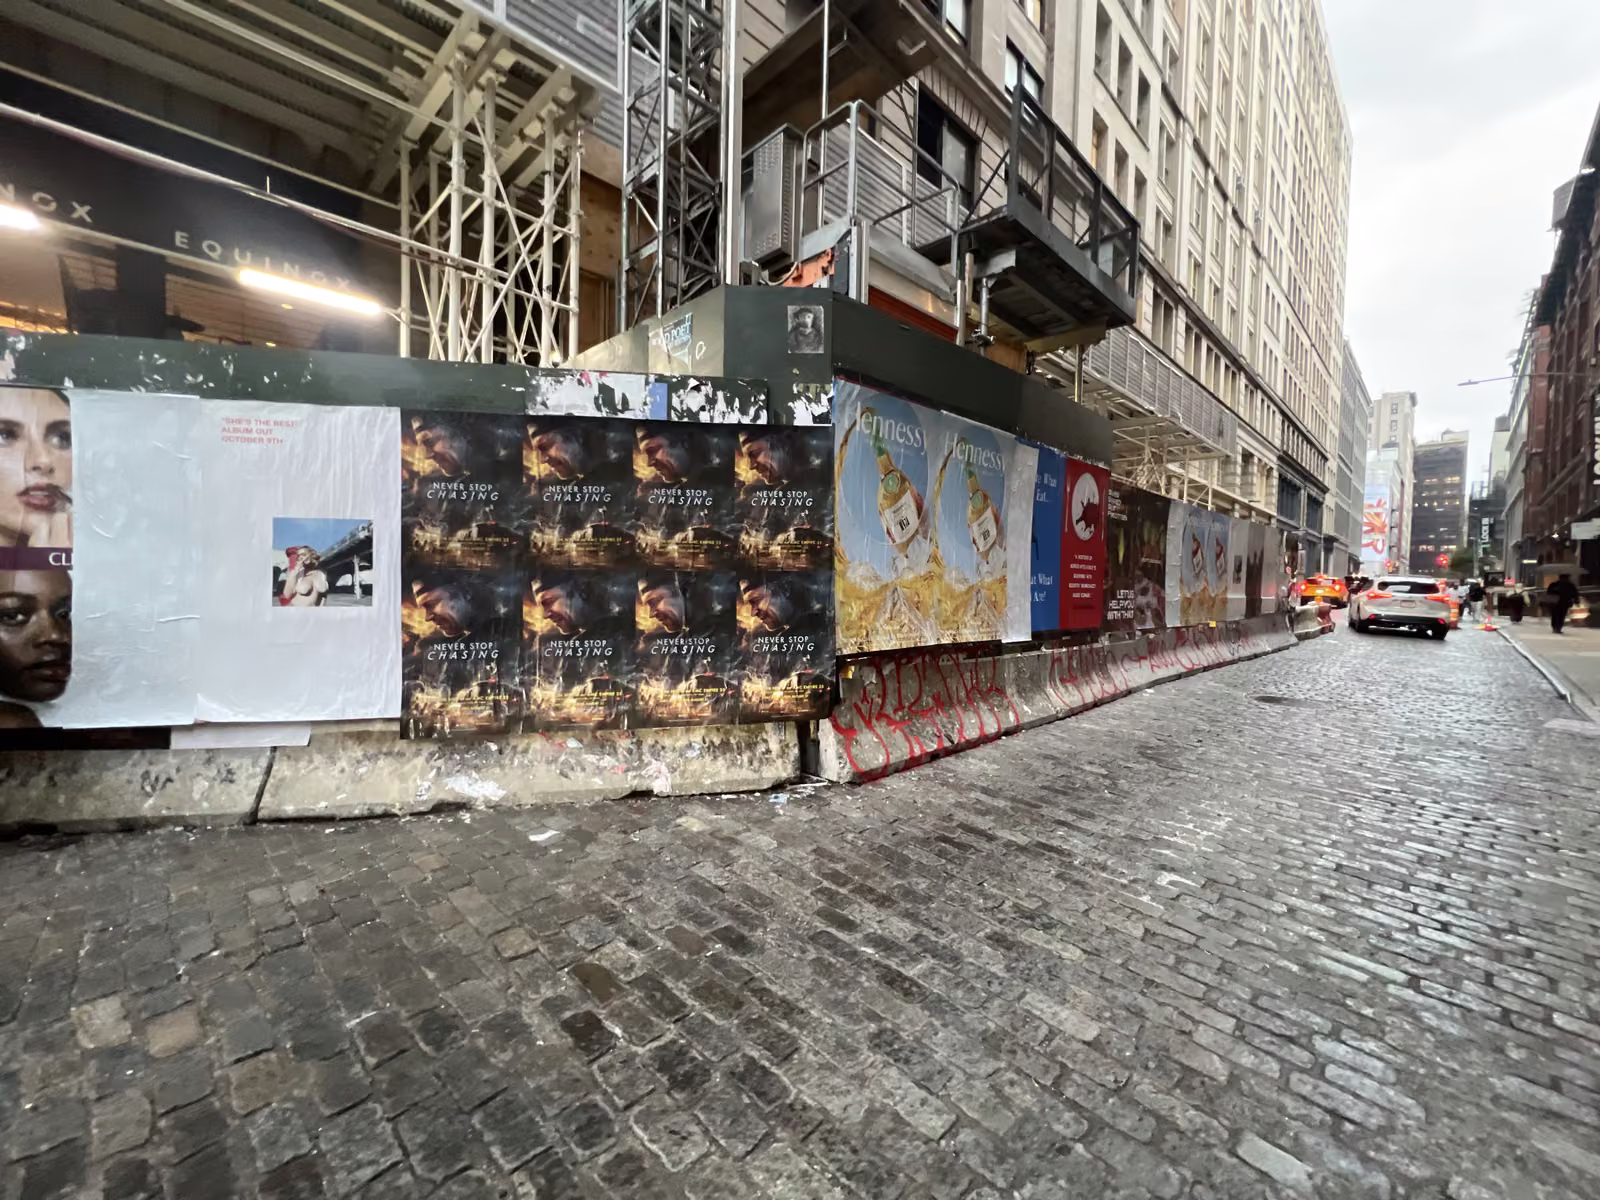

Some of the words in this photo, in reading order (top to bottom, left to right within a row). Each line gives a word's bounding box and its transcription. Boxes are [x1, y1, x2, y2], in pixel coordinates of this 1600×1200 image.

[175, 230, 350, 290] EQUINOX
[255, 418, 271, 426] THE
[844, 401, 927, 456] Hennessy
[222, 435, 264, 444] OCTOBER
[944, 431, 1006, 477] Hennessy
[433, 482, 465, 491] NEVER
[469, 483, 493, 492] STOP
[548, 485, 579, 493] NEVER
[582, 485, 606, 493] STOP
[426, 490, 499, 501] CHASING
[543, 493, 612, 502] CHASING
[653, 488, 682, 496] NEVER
[685, 489, 708, 497] STOP
[756, 490, 783, 498] NEVER
[786, 490, 808, 498] STOP
[648, 495, 713, 506] CHASING
[751, 498, 813, 507] CHASING
[550, 640, 580, 648] NEVER
[584, 640, 607, 648] STOP
[656, 638, 685, 646] NEVER
[688, 637, 710, 645] STOP
[757, 636, 785, 644] NEVER
[788, 635, 809, 643] STOP
[433, 642, 465, 651] NEVER
[469, 641, 493, 650] STOP
[651, 645, 716, 655] CHASING
[753, 643, 815, 653] CHASING
[427, 649, 500, 661] CHASING
[544, 647, 613, 657] CHASING
